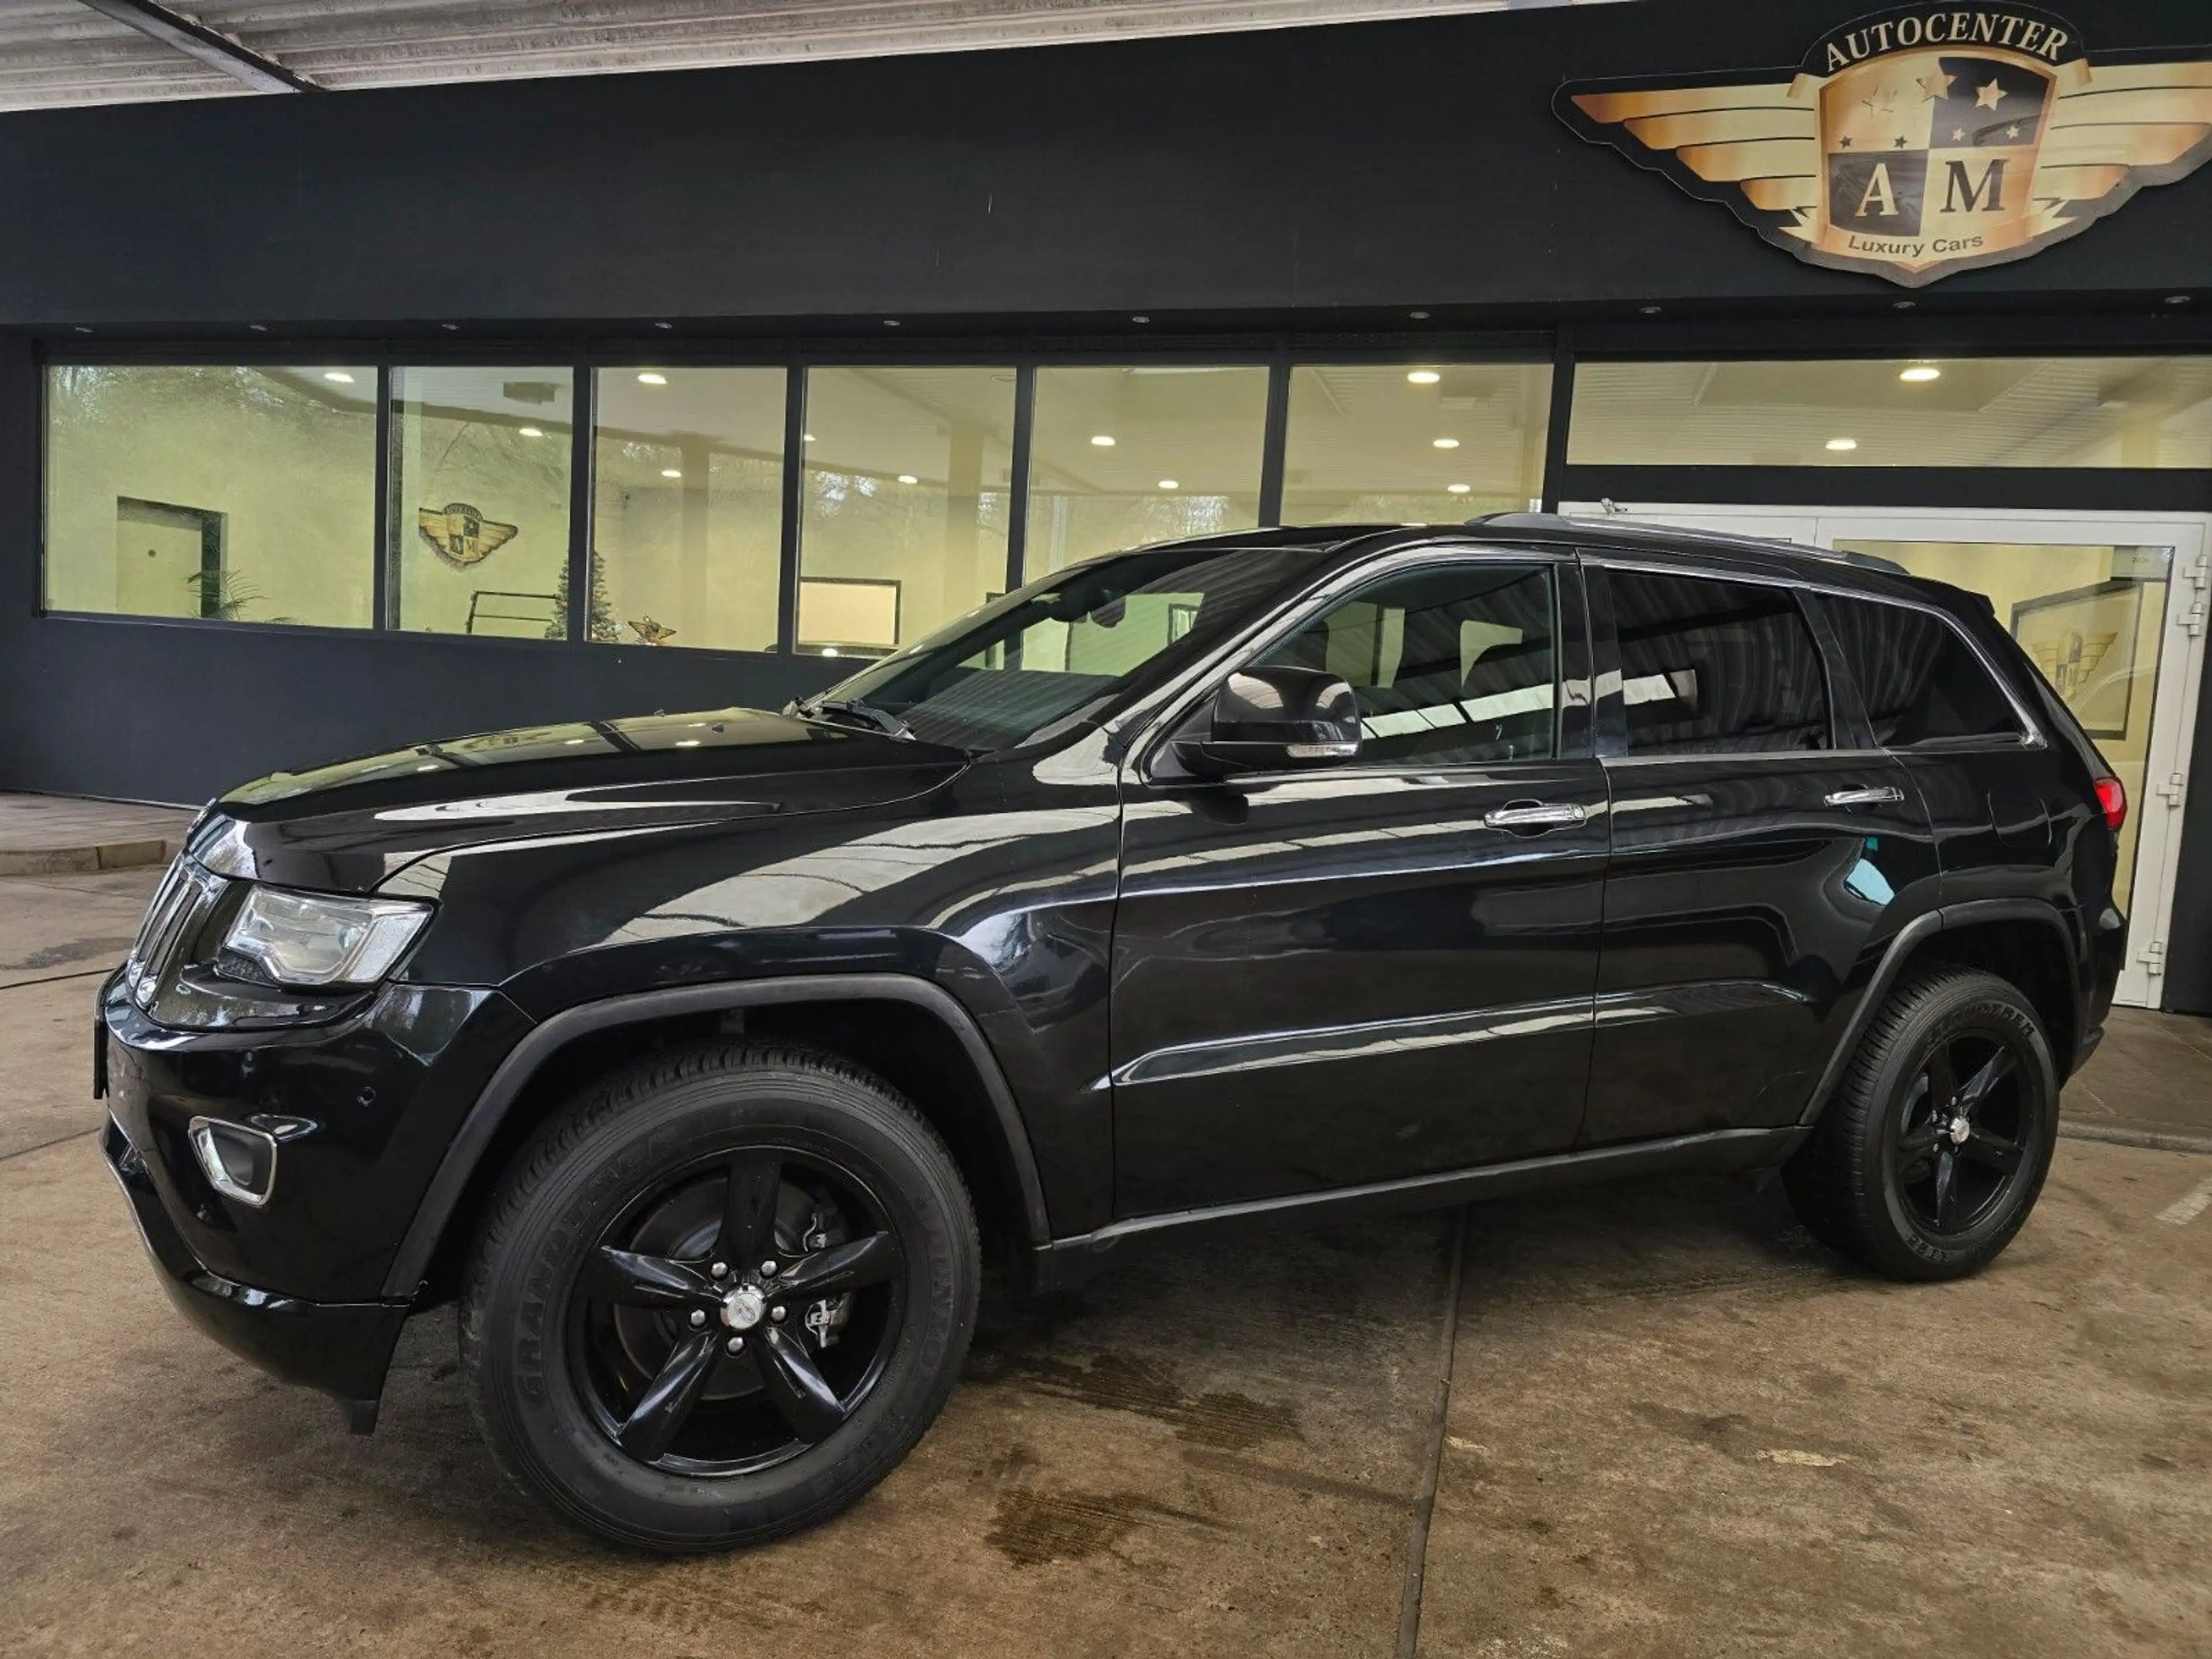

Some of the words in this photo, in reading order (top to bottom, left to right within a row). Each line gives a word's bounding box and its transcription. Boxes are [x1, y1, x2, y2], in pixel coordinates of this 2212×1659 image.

[1827, 12, 2069, 73] AUTOCENTER
[1855, 162, 1900, 217] A
[1940, 158, 2010, 213] M
[1848, 235, 1925, 257] Luxury
[1932, 235, 1984, 252] Cars
